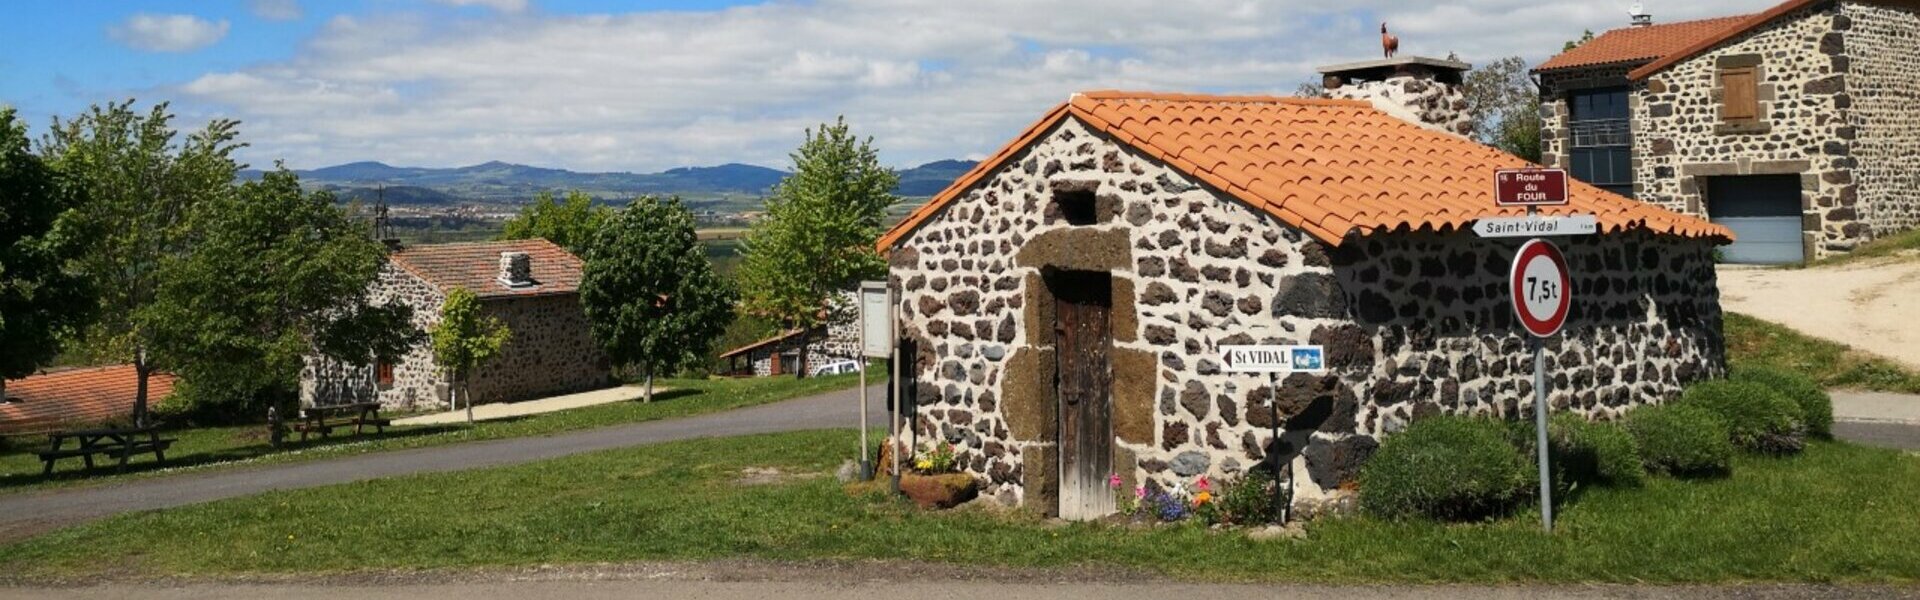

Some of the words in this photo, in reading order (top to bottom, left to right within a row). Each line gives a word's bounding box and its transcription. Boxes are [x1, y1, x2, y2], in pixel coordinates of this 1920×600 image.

[1516, 173, 1545, 182] Route
[1525, 183, 1537, 191] du
[1517, 193, 1546, 201] FOUR
[1486, 221, 1558, 233] Saint-Vidal
[1527, 277, 1557, 303] 7,5t
[1235, 351, 1246, 364] St
[1249, 350, 1288, 364] VIDAL
